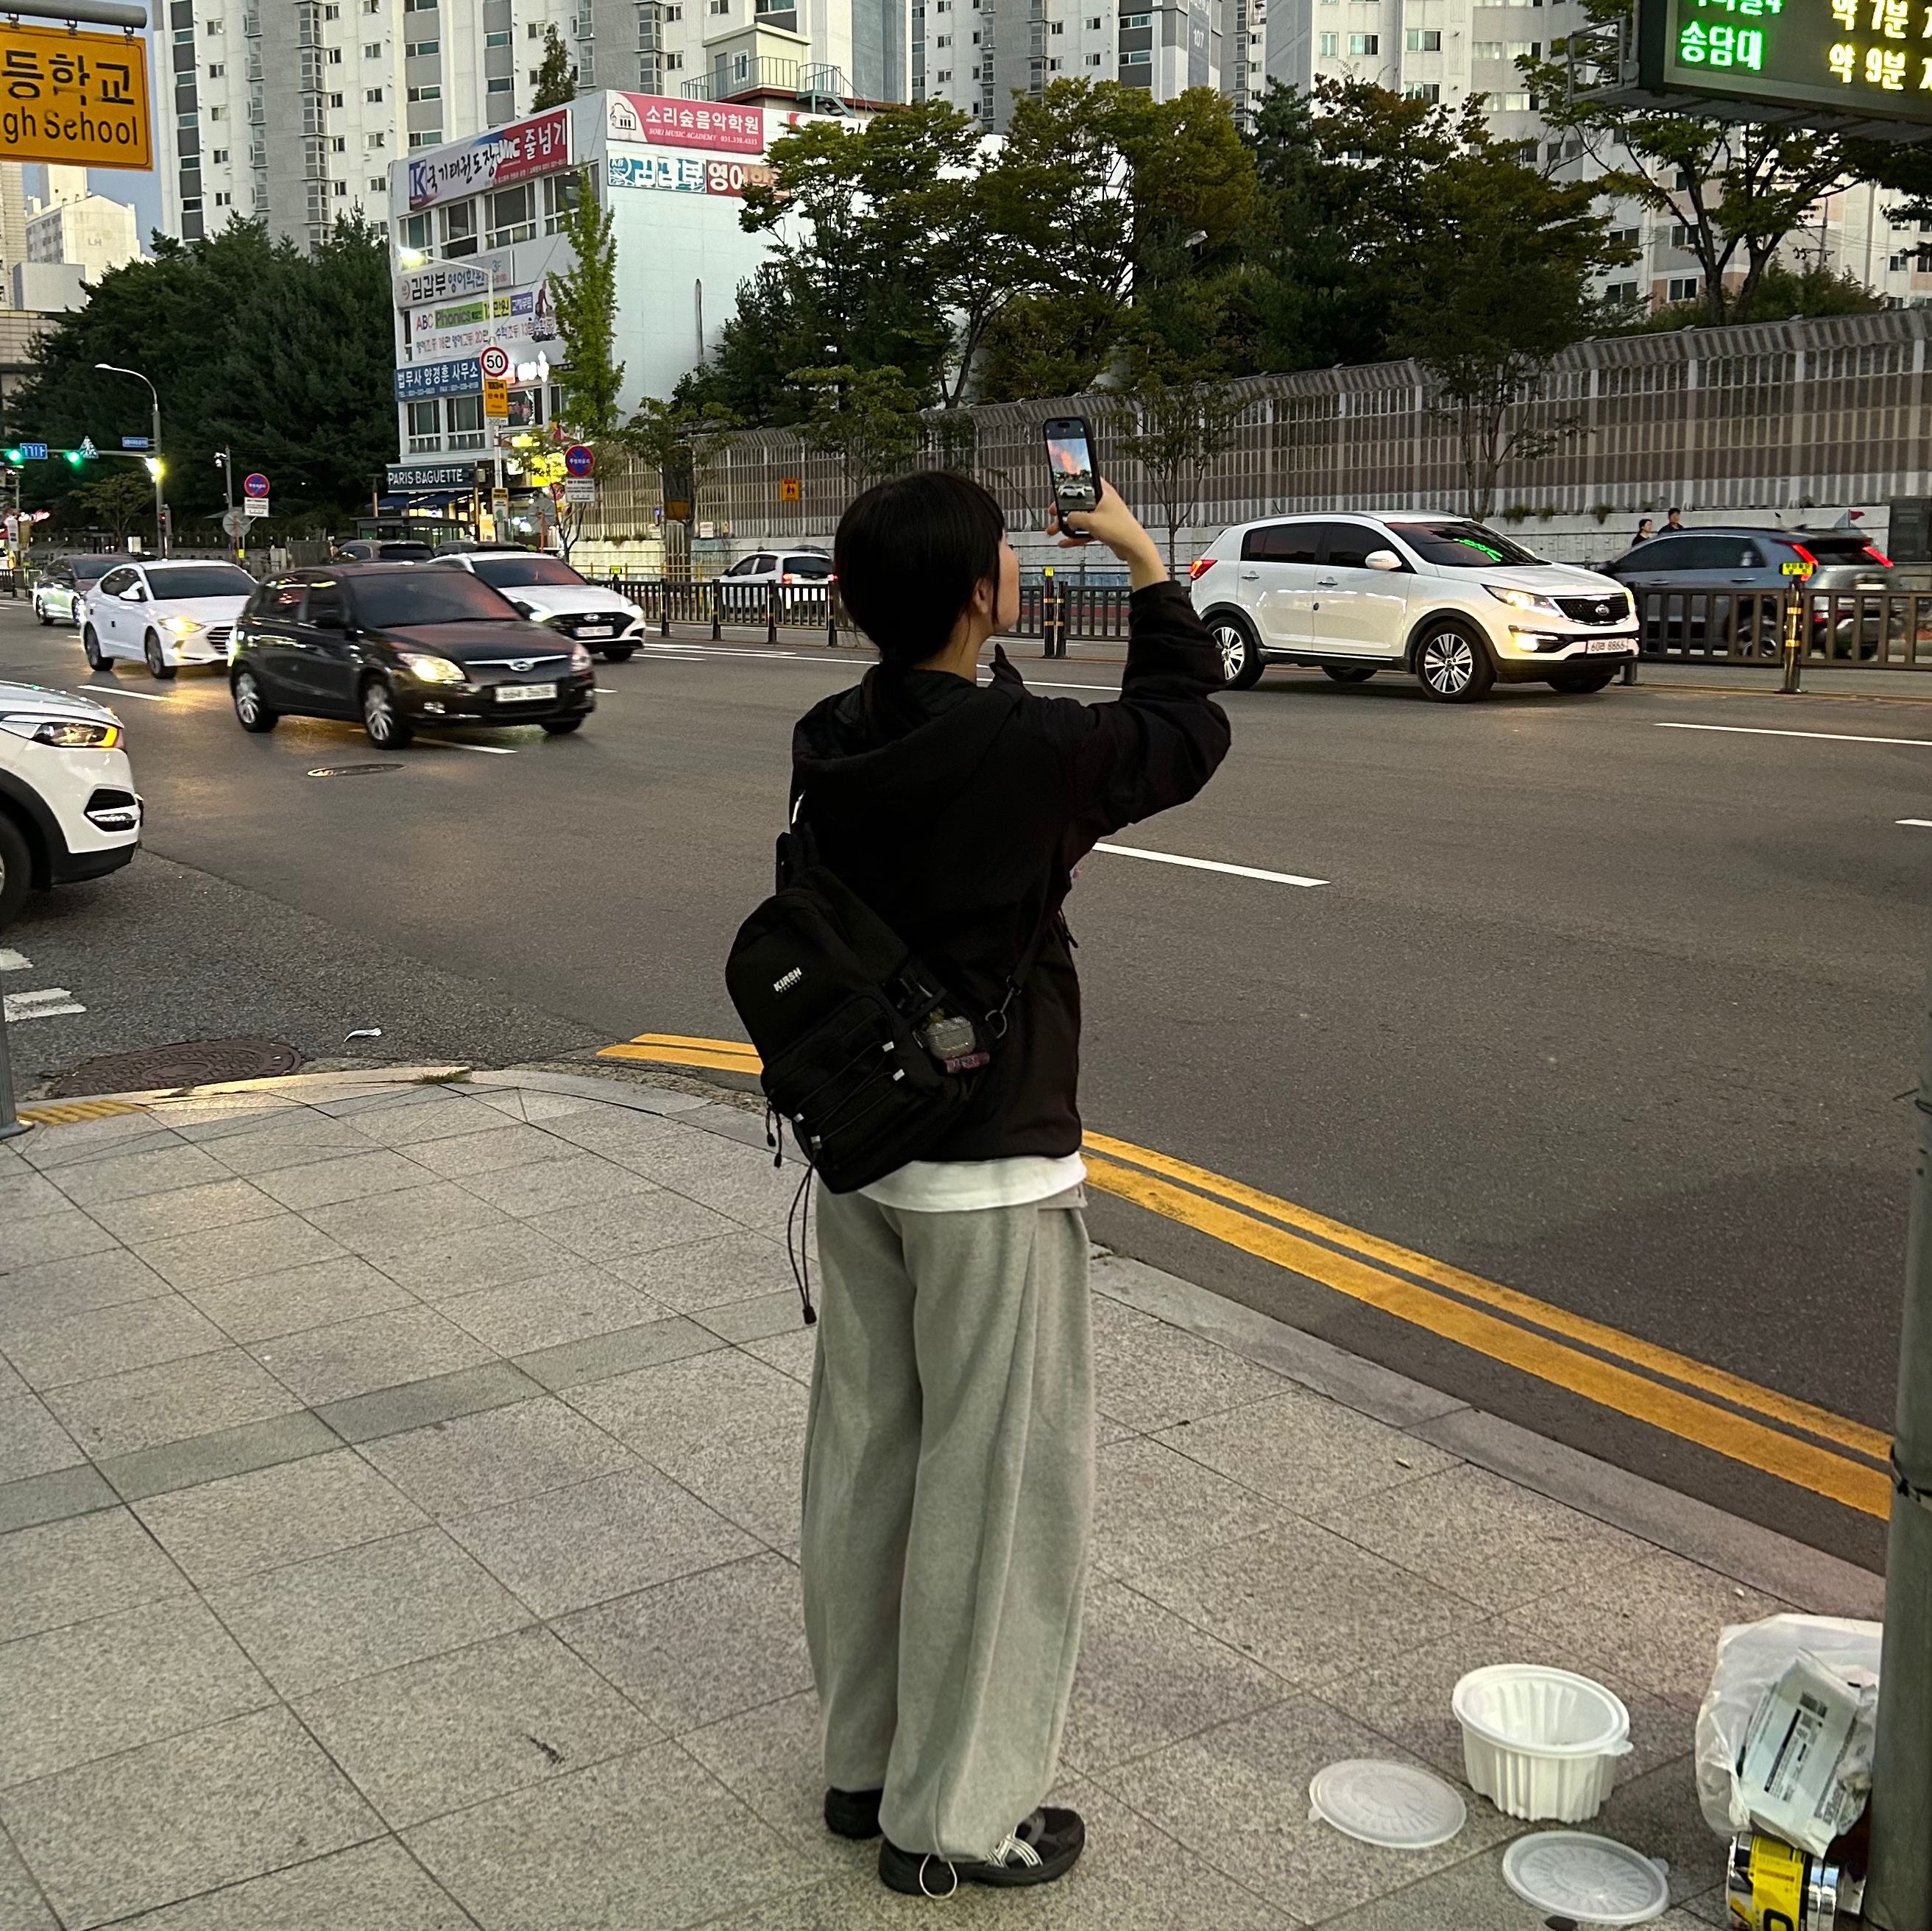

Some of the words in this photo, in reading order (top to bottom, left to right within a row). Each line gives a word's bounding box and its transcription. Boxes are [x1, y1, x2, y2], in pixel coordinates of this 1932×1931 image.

[1194, 28, 1205, 49] 107
[1680, 21, 1763, 71] 송담대
[1829, 43, 1856, 84] 약
[1865, 47, 1907, 91] 9분
[1, 49, 135, 106] 등학교
[0, 106, 37, 144] gh
[43, 109, 138, 146] School
[645, 105, 760, 135] 소리숲음악학원
[648, 127, 664, 136] SORI
[664, 129, 686, 138] MUSIC
[686, 132, 717, 141] ACADEMY
[524, 118, 566, 160] 줄넘기
[492, 260, 502, 273] 3F
[411, 272, 446, 301] 김갑부
[447, 268, 485, 294] 영어학원
[416, 314, 434, 331] ABC
[436, 310, 471, 327] Phonics
[397, 369, 422, 389] 법무사
[452, 361, 479, 381] 사무소
[486, 355, 503, 369] 50
[388, 471, 414, 486] PARIS
[415, 468, 464, 485] BAGUETTE
